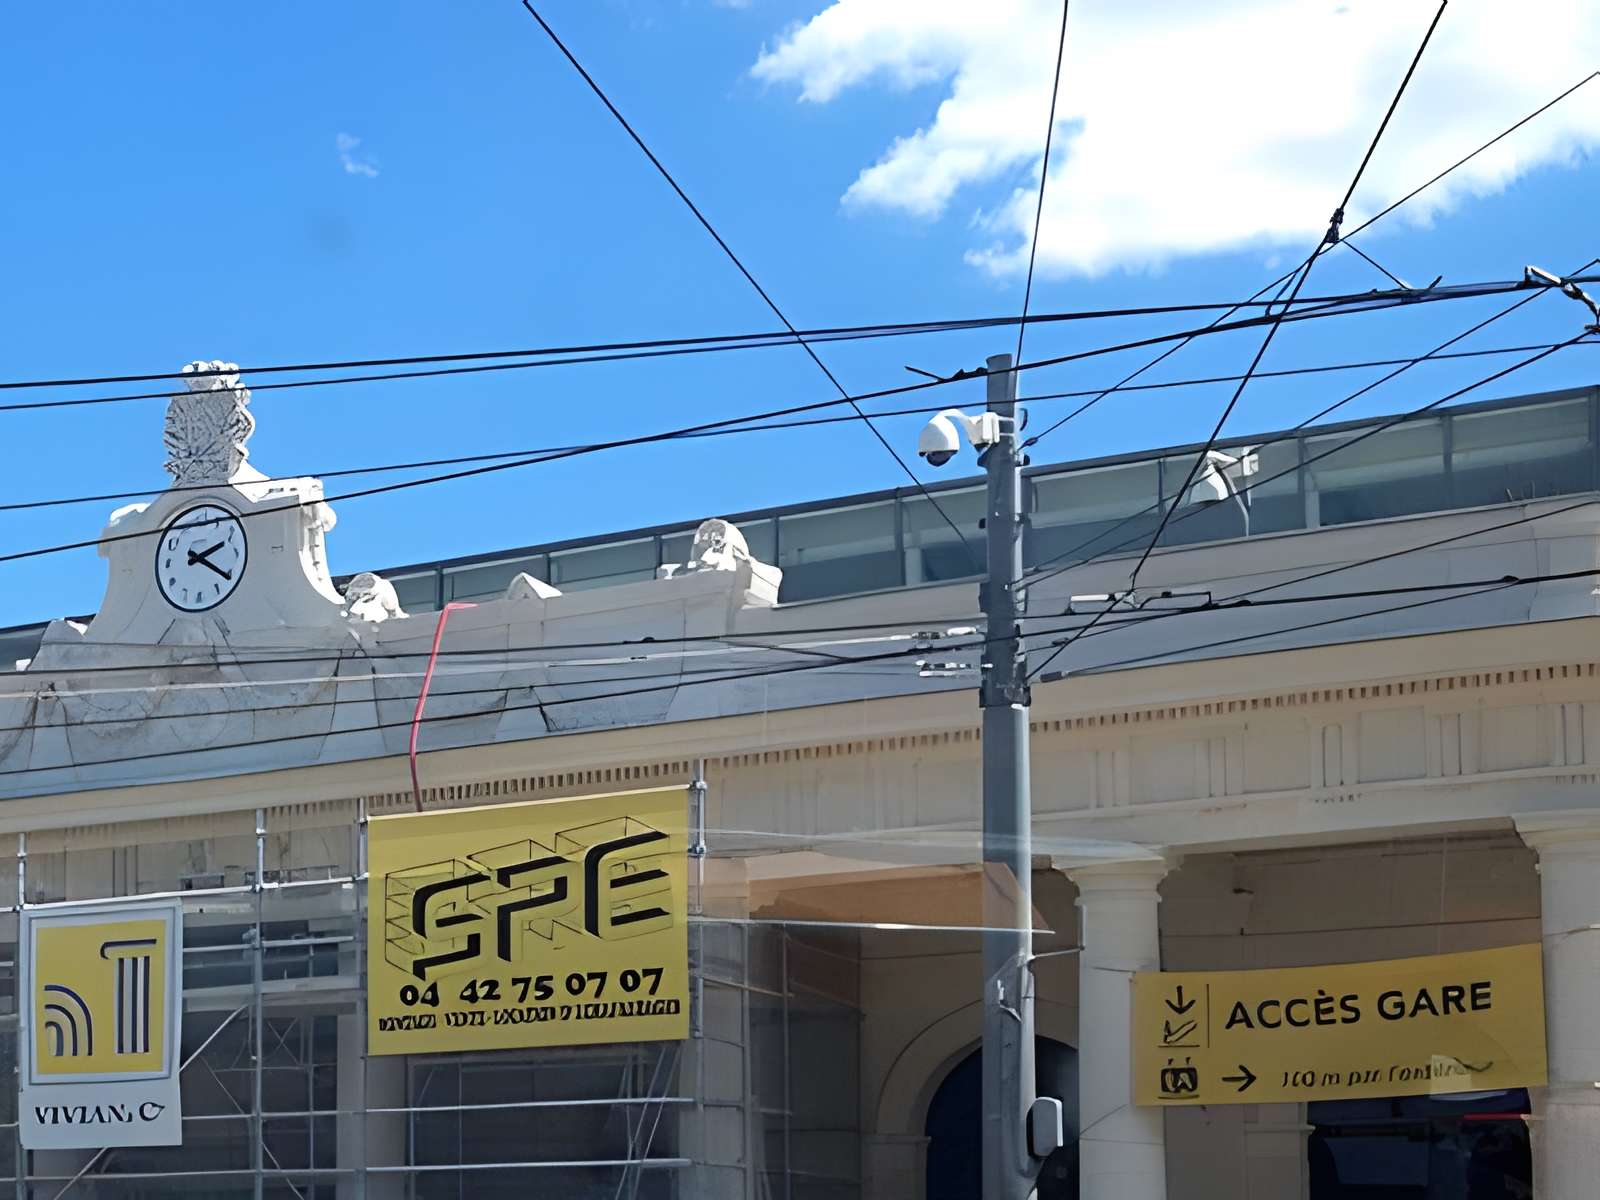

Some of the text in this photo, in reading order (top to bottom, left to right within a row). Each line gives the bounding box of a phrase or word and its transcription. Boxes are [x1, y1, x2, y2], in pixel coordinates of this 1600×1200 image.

[410, 829, 672, 980] SPE
[400, 967, 664, 1007] 04 42 75 07 07
[1224, 981, 1492, 1030] ACCÈS GARE
